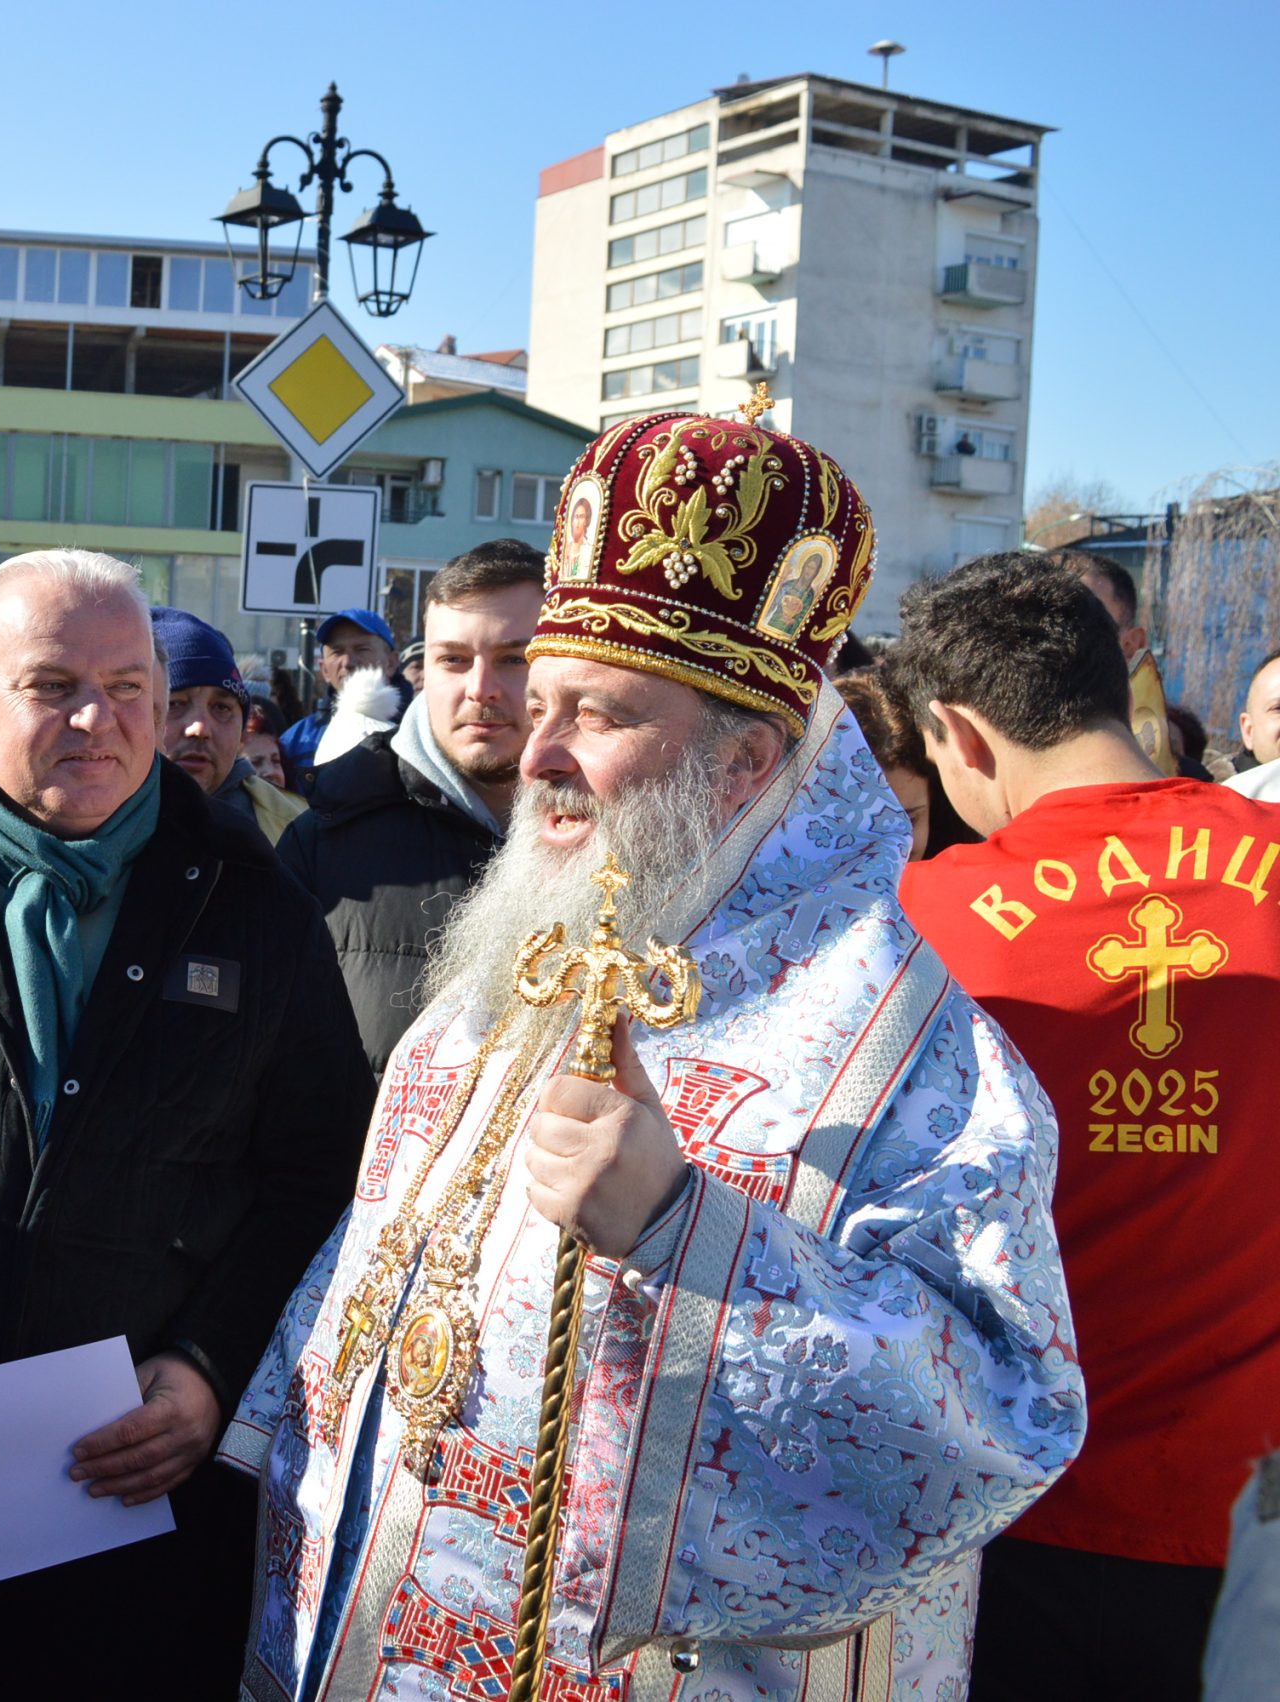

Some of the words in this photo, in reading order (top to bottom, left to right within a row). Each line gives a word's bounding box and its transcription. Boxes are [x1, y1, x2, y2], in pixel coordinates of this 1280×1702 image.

[969, 826, 1280, 941] ВОДИЦ
[1088, 1068, 1219, 1116] 2025
[1088, 1124, 1218, 1154] ZEGIN
